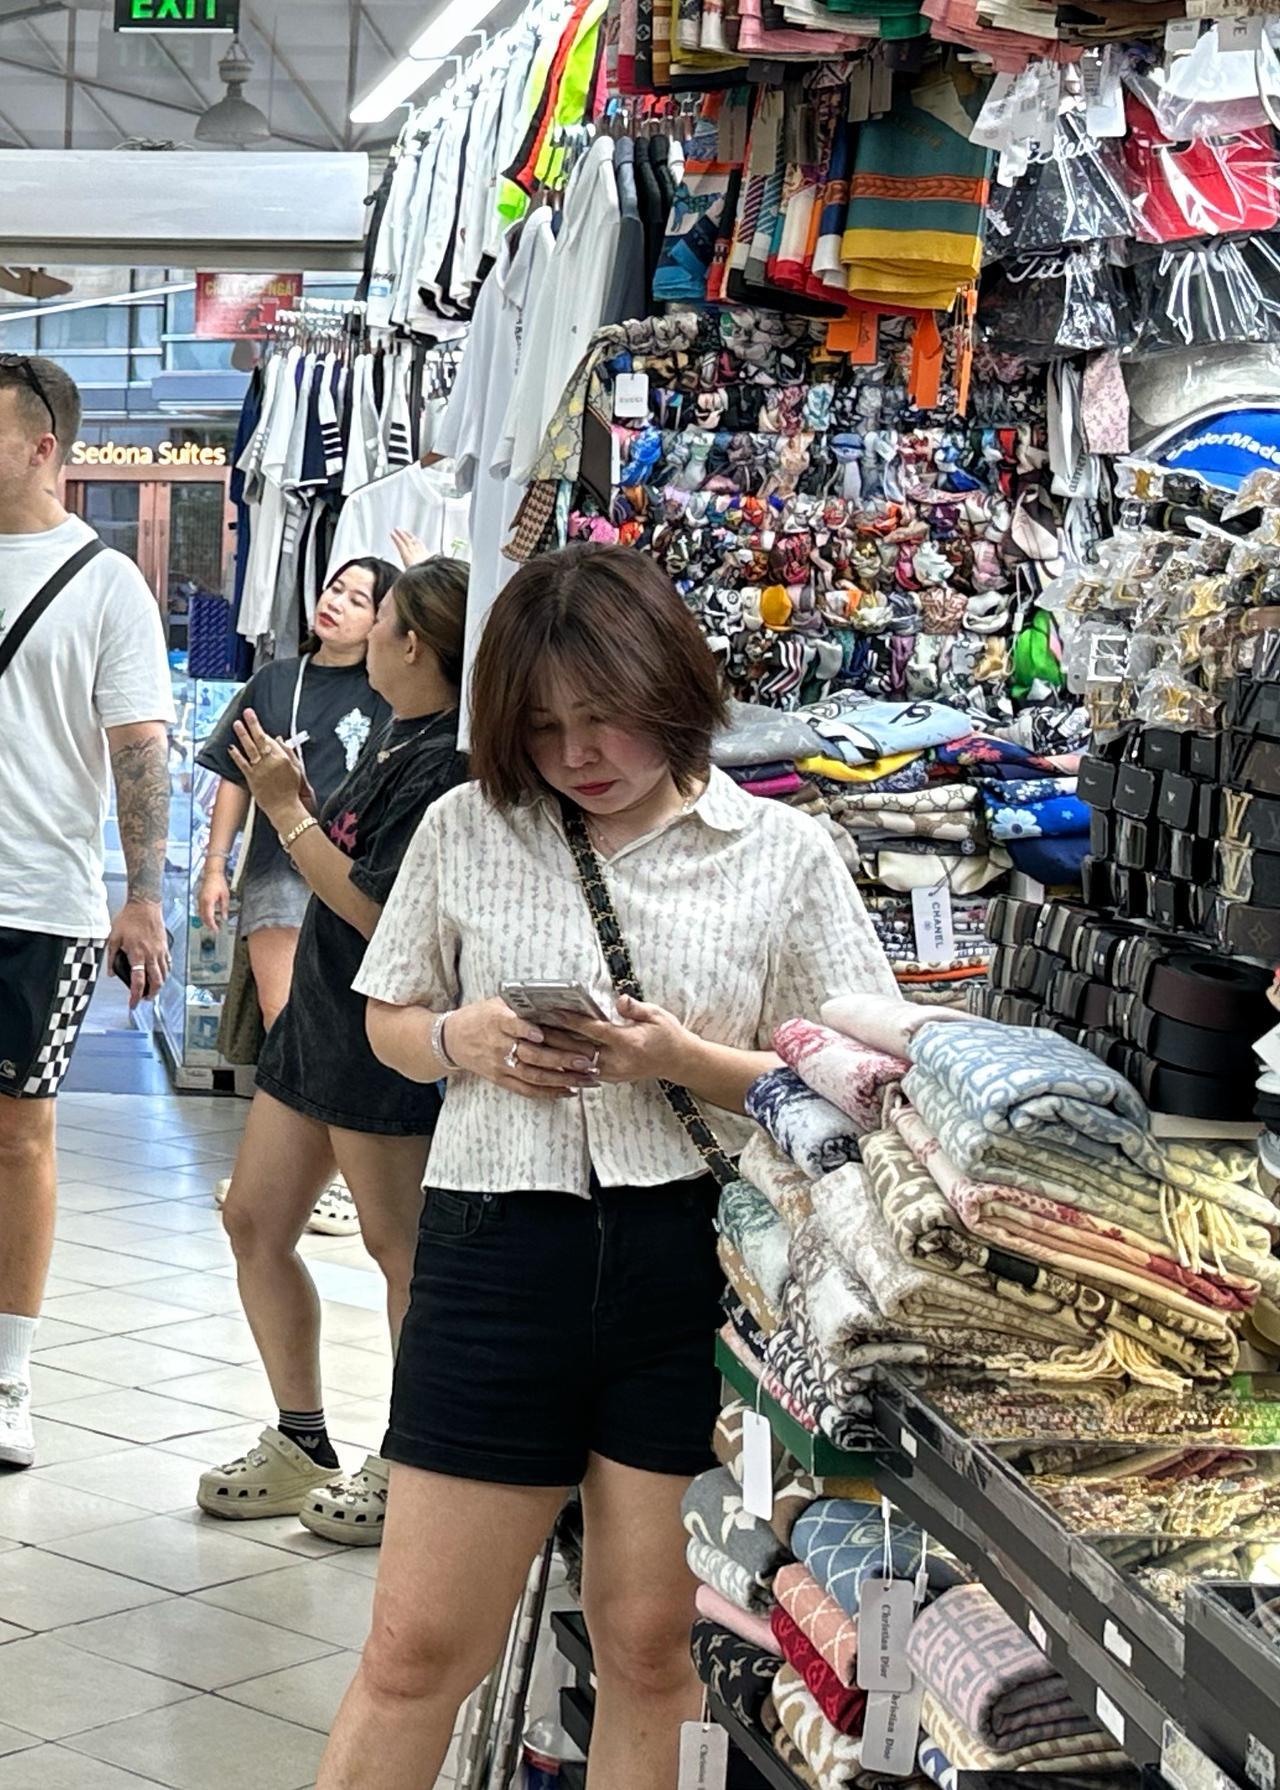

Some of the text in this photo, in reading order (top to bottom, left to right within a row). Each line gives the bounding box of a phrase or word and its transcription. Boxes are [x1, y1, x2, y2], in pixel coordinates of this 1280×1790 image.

[71, 441, 227, 465] Sedona Suites
[932, 901, 944, 949] CHANEL
[879, 1603, 892, 1679] Christian Dior
[883, 1691, 901, 1761] hristian Dior
